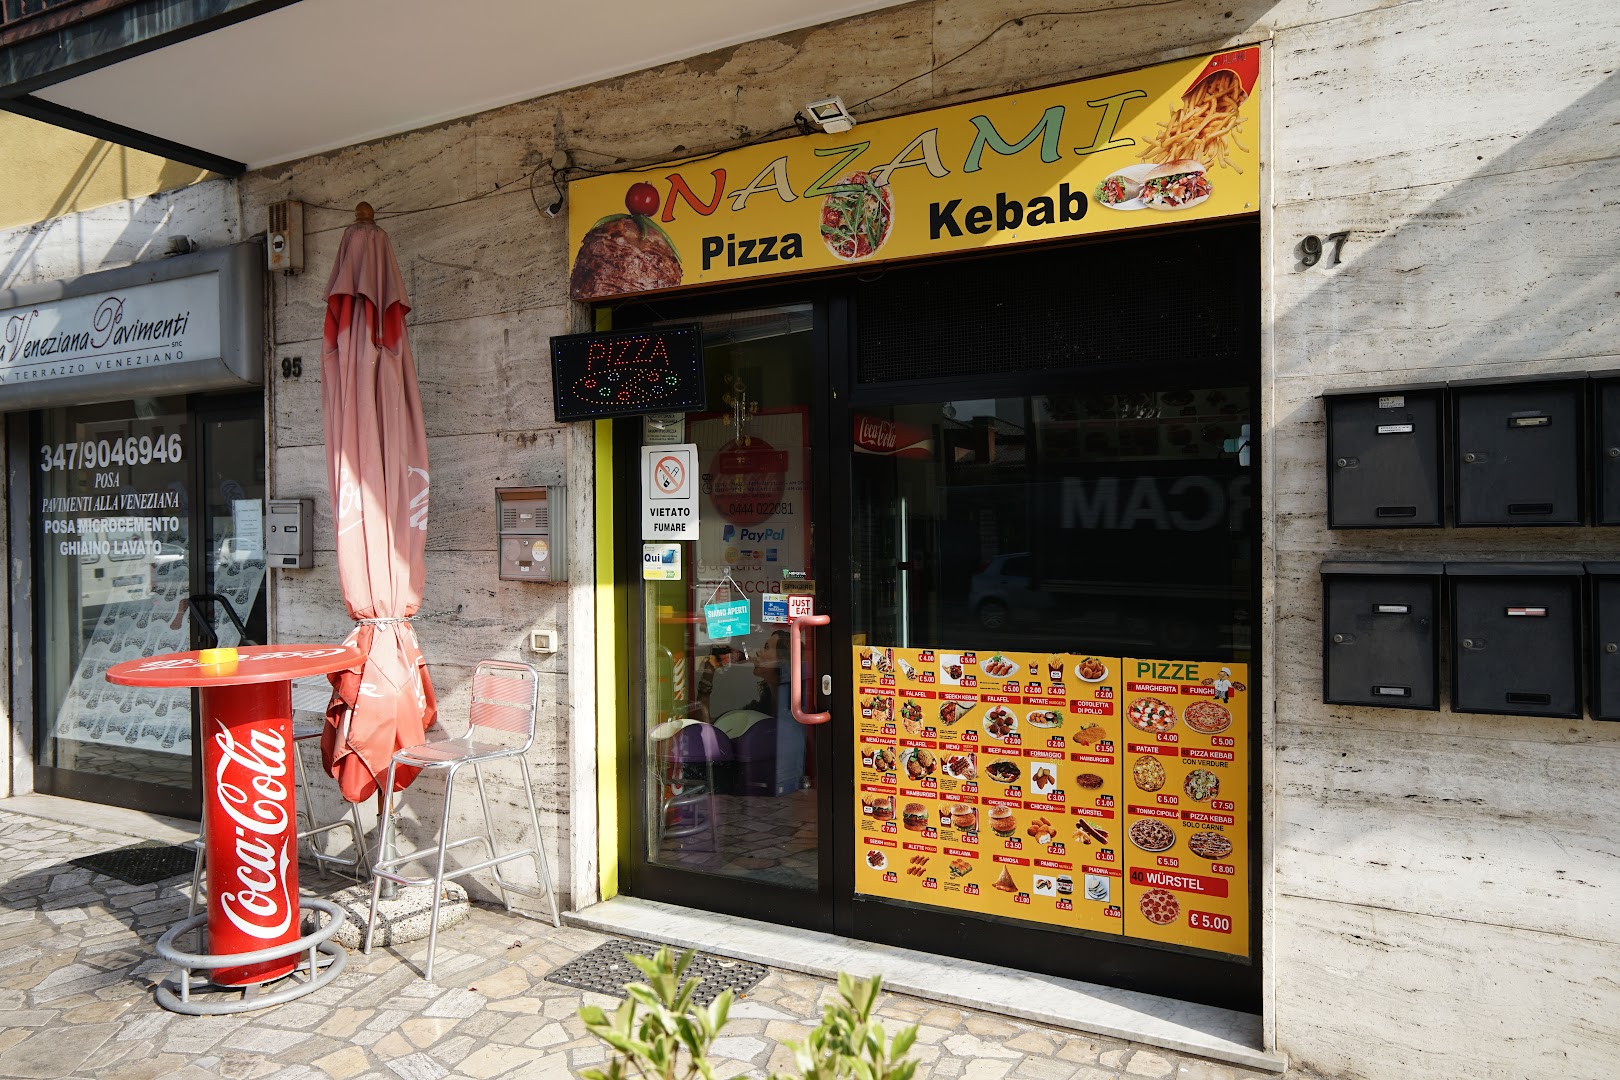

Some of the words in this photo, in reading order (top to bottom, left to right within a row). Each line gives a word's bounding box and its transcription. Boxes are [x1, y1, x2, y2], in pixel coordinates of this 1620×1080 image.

[661, 89, 1148, 222] NAZAMI
[701, 232, 803, 271] Pizza
[929, 182, 1089, 240] Kebab
[1300, 230, 1351, 267] 97
[6, 309, 90, 363] Veneziana
[90, 296, 190, 349] Pavimenti
[587, 337, 669, 370] PIZZA
[15, 364, 85, 380] TERRAZZO
[95, 350, 184, 370] VENEZIANO
[281, 356, 302, 379] 95
[859, 416, 897, 448] Coca-Cola
[40, 433, 182, 472] 347/9046946
[94, 472, 120, 489] POSA
[42, 496, 93, 513] PAVIMENTI
[93, 495, 118, 511] ALLA
[120, 491, 179, 510] VENEZIANA
[729, 503, 753, 515] 0444
[756, 502, 794, 515] 022081
[650, 507, 691, 517] VIETATO
[44, 519, 76, 534] POSA
[77, 516, 180, 533] MICROCEMENTO
[654, 523, 686, 532] FUMARE
[740, 528, 785, 543] PayPal
[60, 540, 111, 556] GHIAINO
[113, 539, 162, 555] LAVATO
[644, 553, 660, 563] Qui
[791, 599, 811, 607] JUST
[707, 608, 727, 618] SIAMO
[727, 605, 748, 616] APERTI
[795, 607, 811, 615] EAT
[1137, 661, 1199, 681] PIZZE
[1136, 684, 1177, 693] MARGHERITA
[1218, 738, 1234, 746] 5.00
[1136, 746, 1159, 754] PATATE
[1210, 752, 1233, 760] KEBAB
[1198, 759, 1228, 768] VERDURE
[1164, 796, 1178, 804] 5.00
[1218, 802, 1234, 810] 7.50
[1078, 808, 1104, 816] WÜRSTEL
[1156, 809, 1180, 818] CIPOLLA
[1190, 813, 1208, 821] PIZZA
[1210, 815, 1233, 824] KEBAB
[215, 717, 292, 939] Coca-Cola
[1182, 821, 1200, 829] SOLO
[1202, 823, 1224, 832] CARNE
[1164, 858, 1178, 867] 5.50
[1218, 865, 1234, 874] 8.00
[1132, 871, 1144, 882] 40
[1146, 872, 1204, 890] WÜRSTEL
[1202, 915, 1230, 931] 5.00
